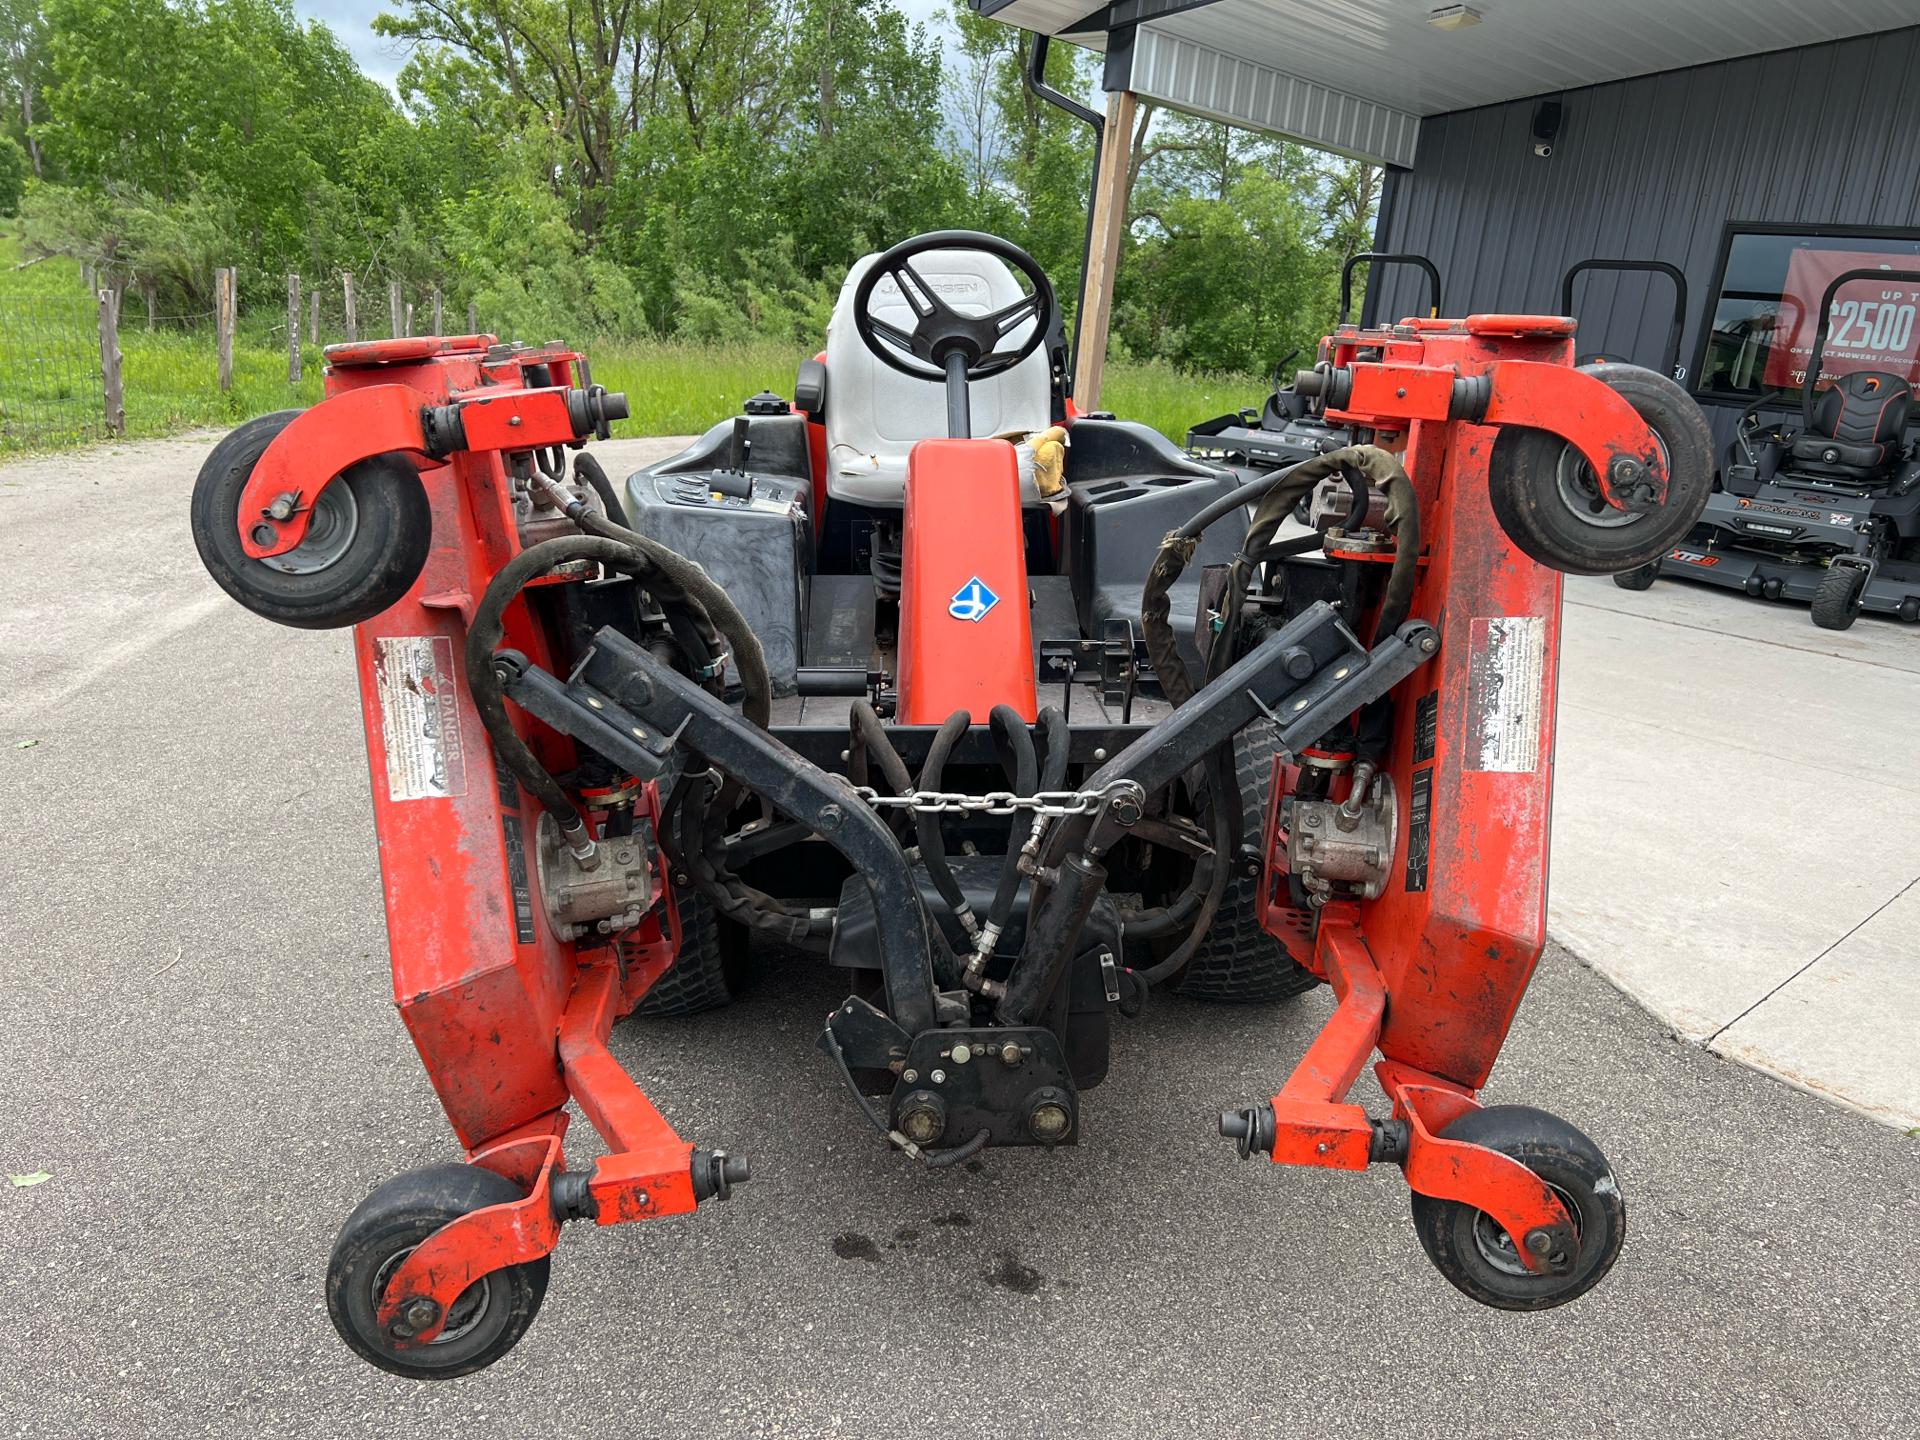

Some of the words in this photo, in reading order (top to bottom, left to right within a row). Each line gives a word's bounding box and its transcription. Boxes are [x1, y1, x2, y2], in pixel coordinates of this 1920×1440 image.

[1882, 291, 1902, 300] UP
[1838, 351, 1876, 360] MOWERS
[1667, 548, 1705, 562] XTF
[1514, 655, 1522, 667] long
[400, 692, 409, 708] being
[440, 694, 460, 762] DANGER
